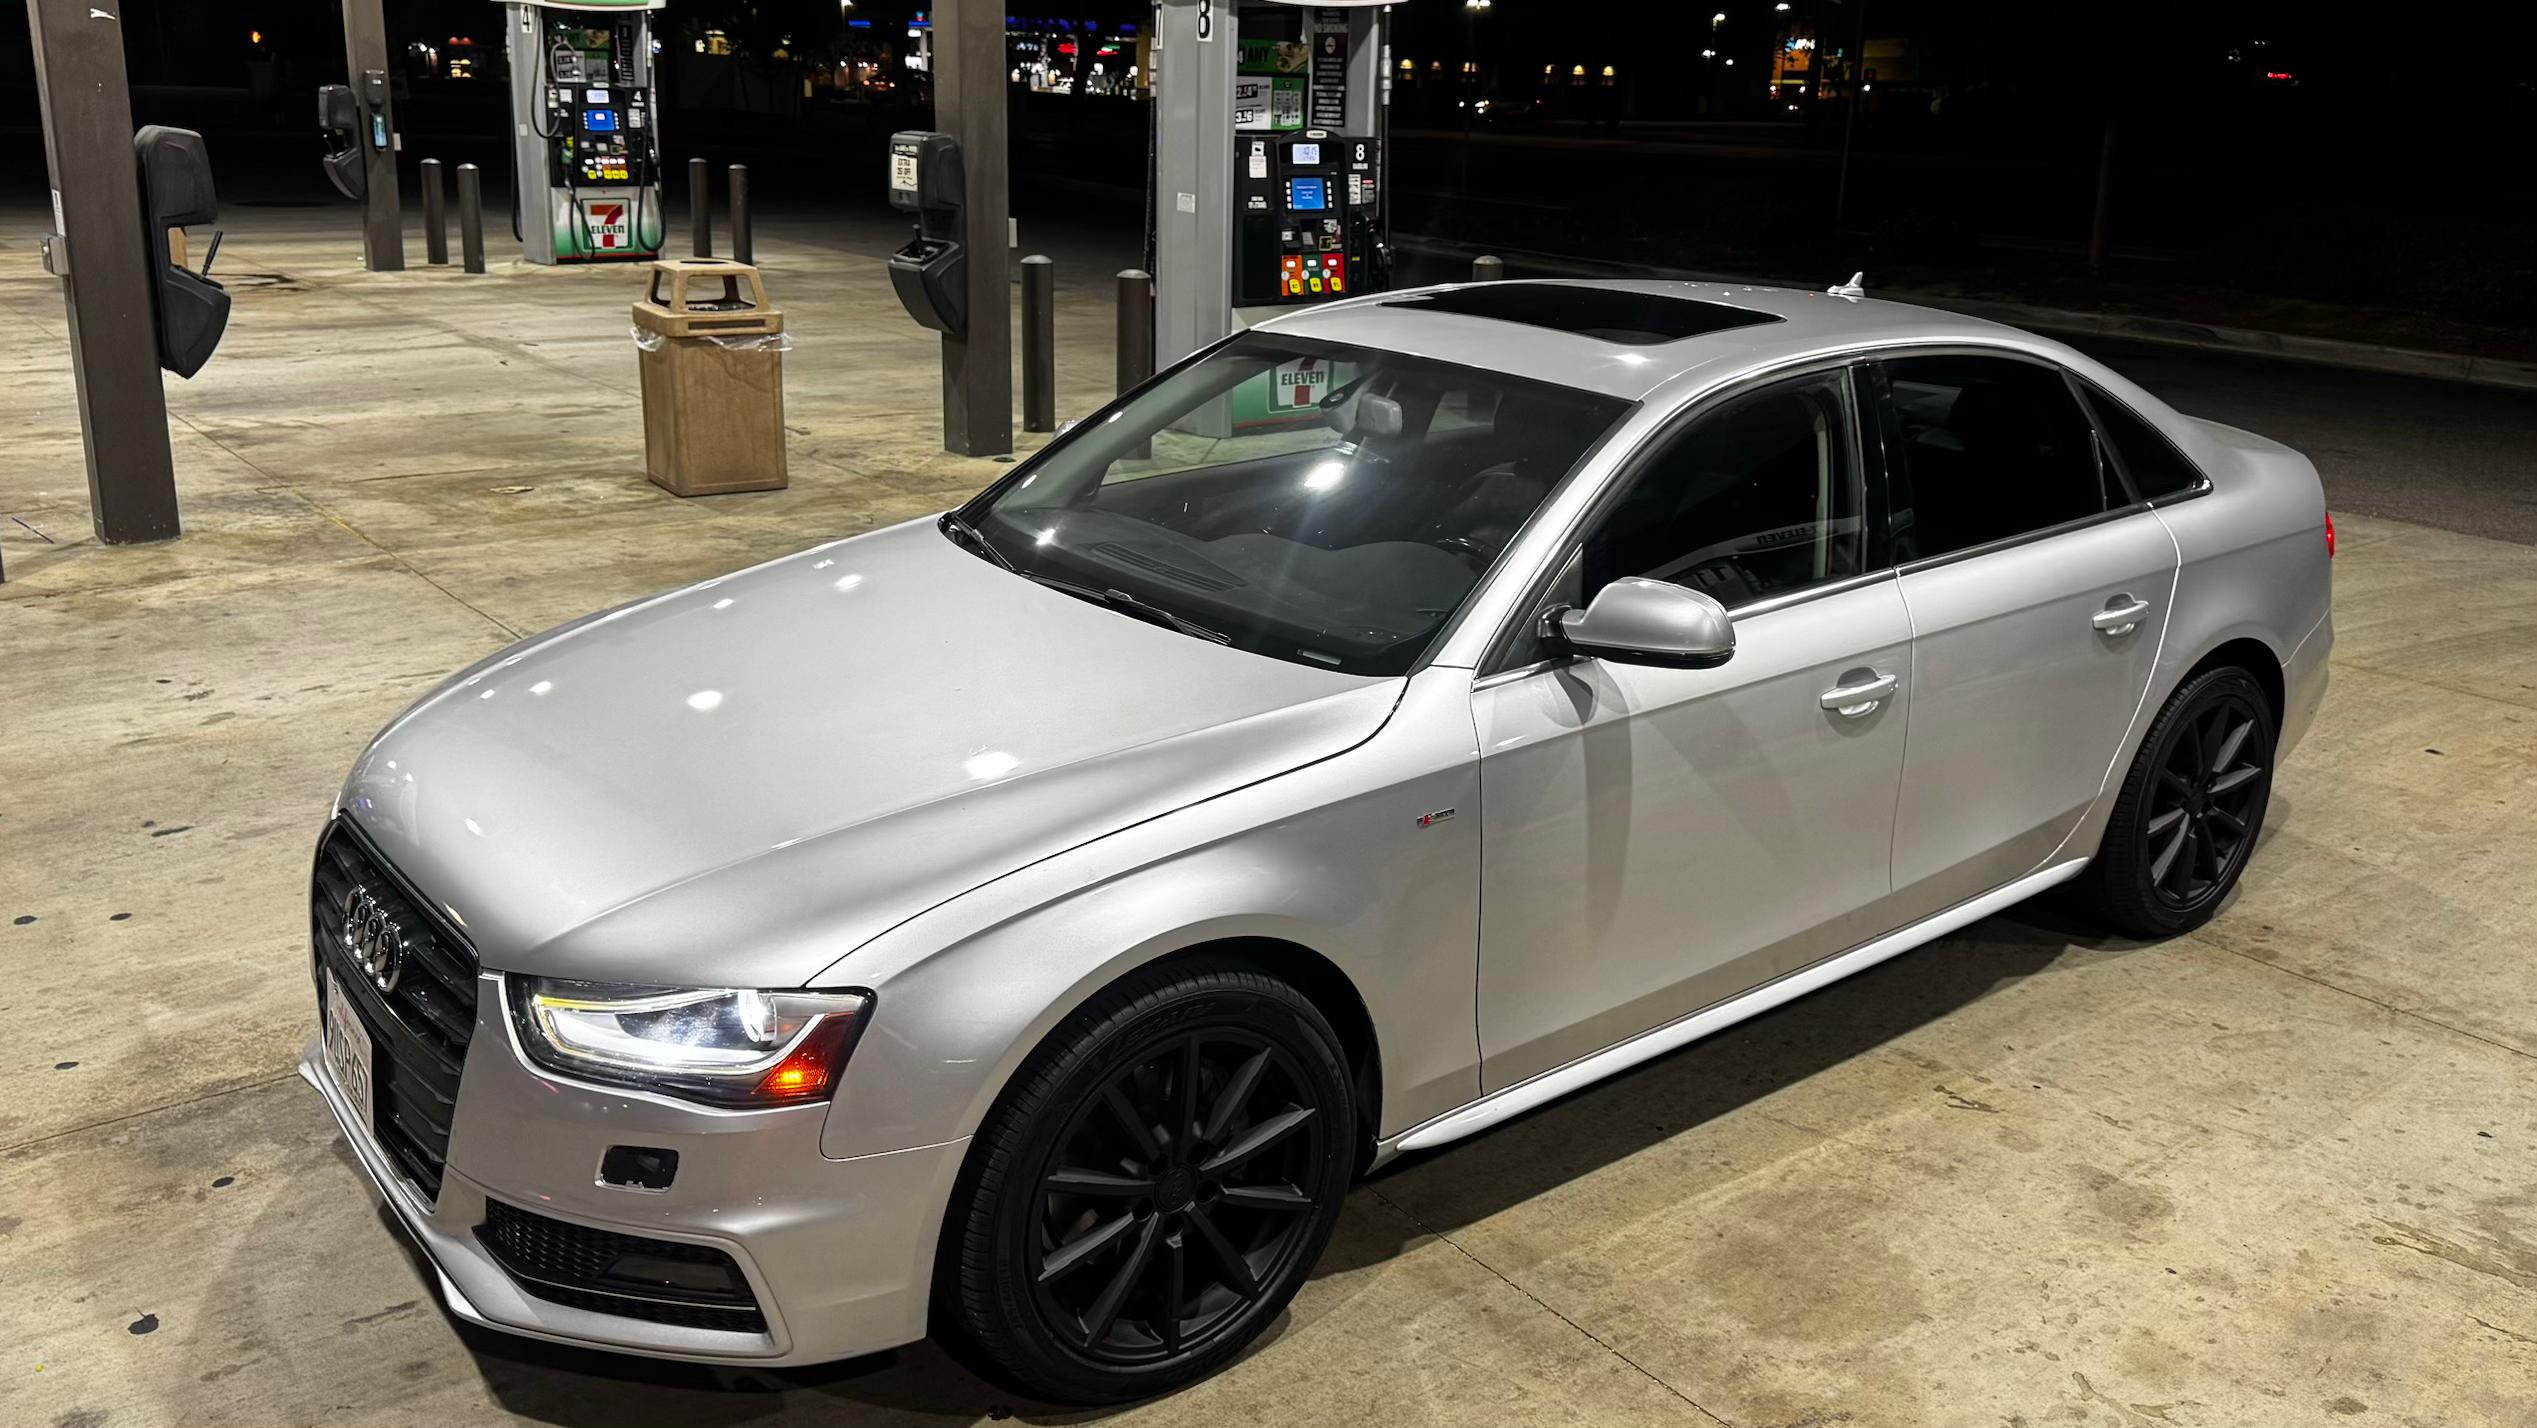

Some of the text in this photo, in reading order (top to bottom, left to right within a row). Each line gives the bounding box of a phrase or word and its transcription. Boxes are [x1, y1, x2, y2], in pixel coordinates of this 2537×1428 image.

[523, 5, 531, 32] 4
[1198, 0, 1211, 40] 8
[1355, 143, 1366, 161] 8
